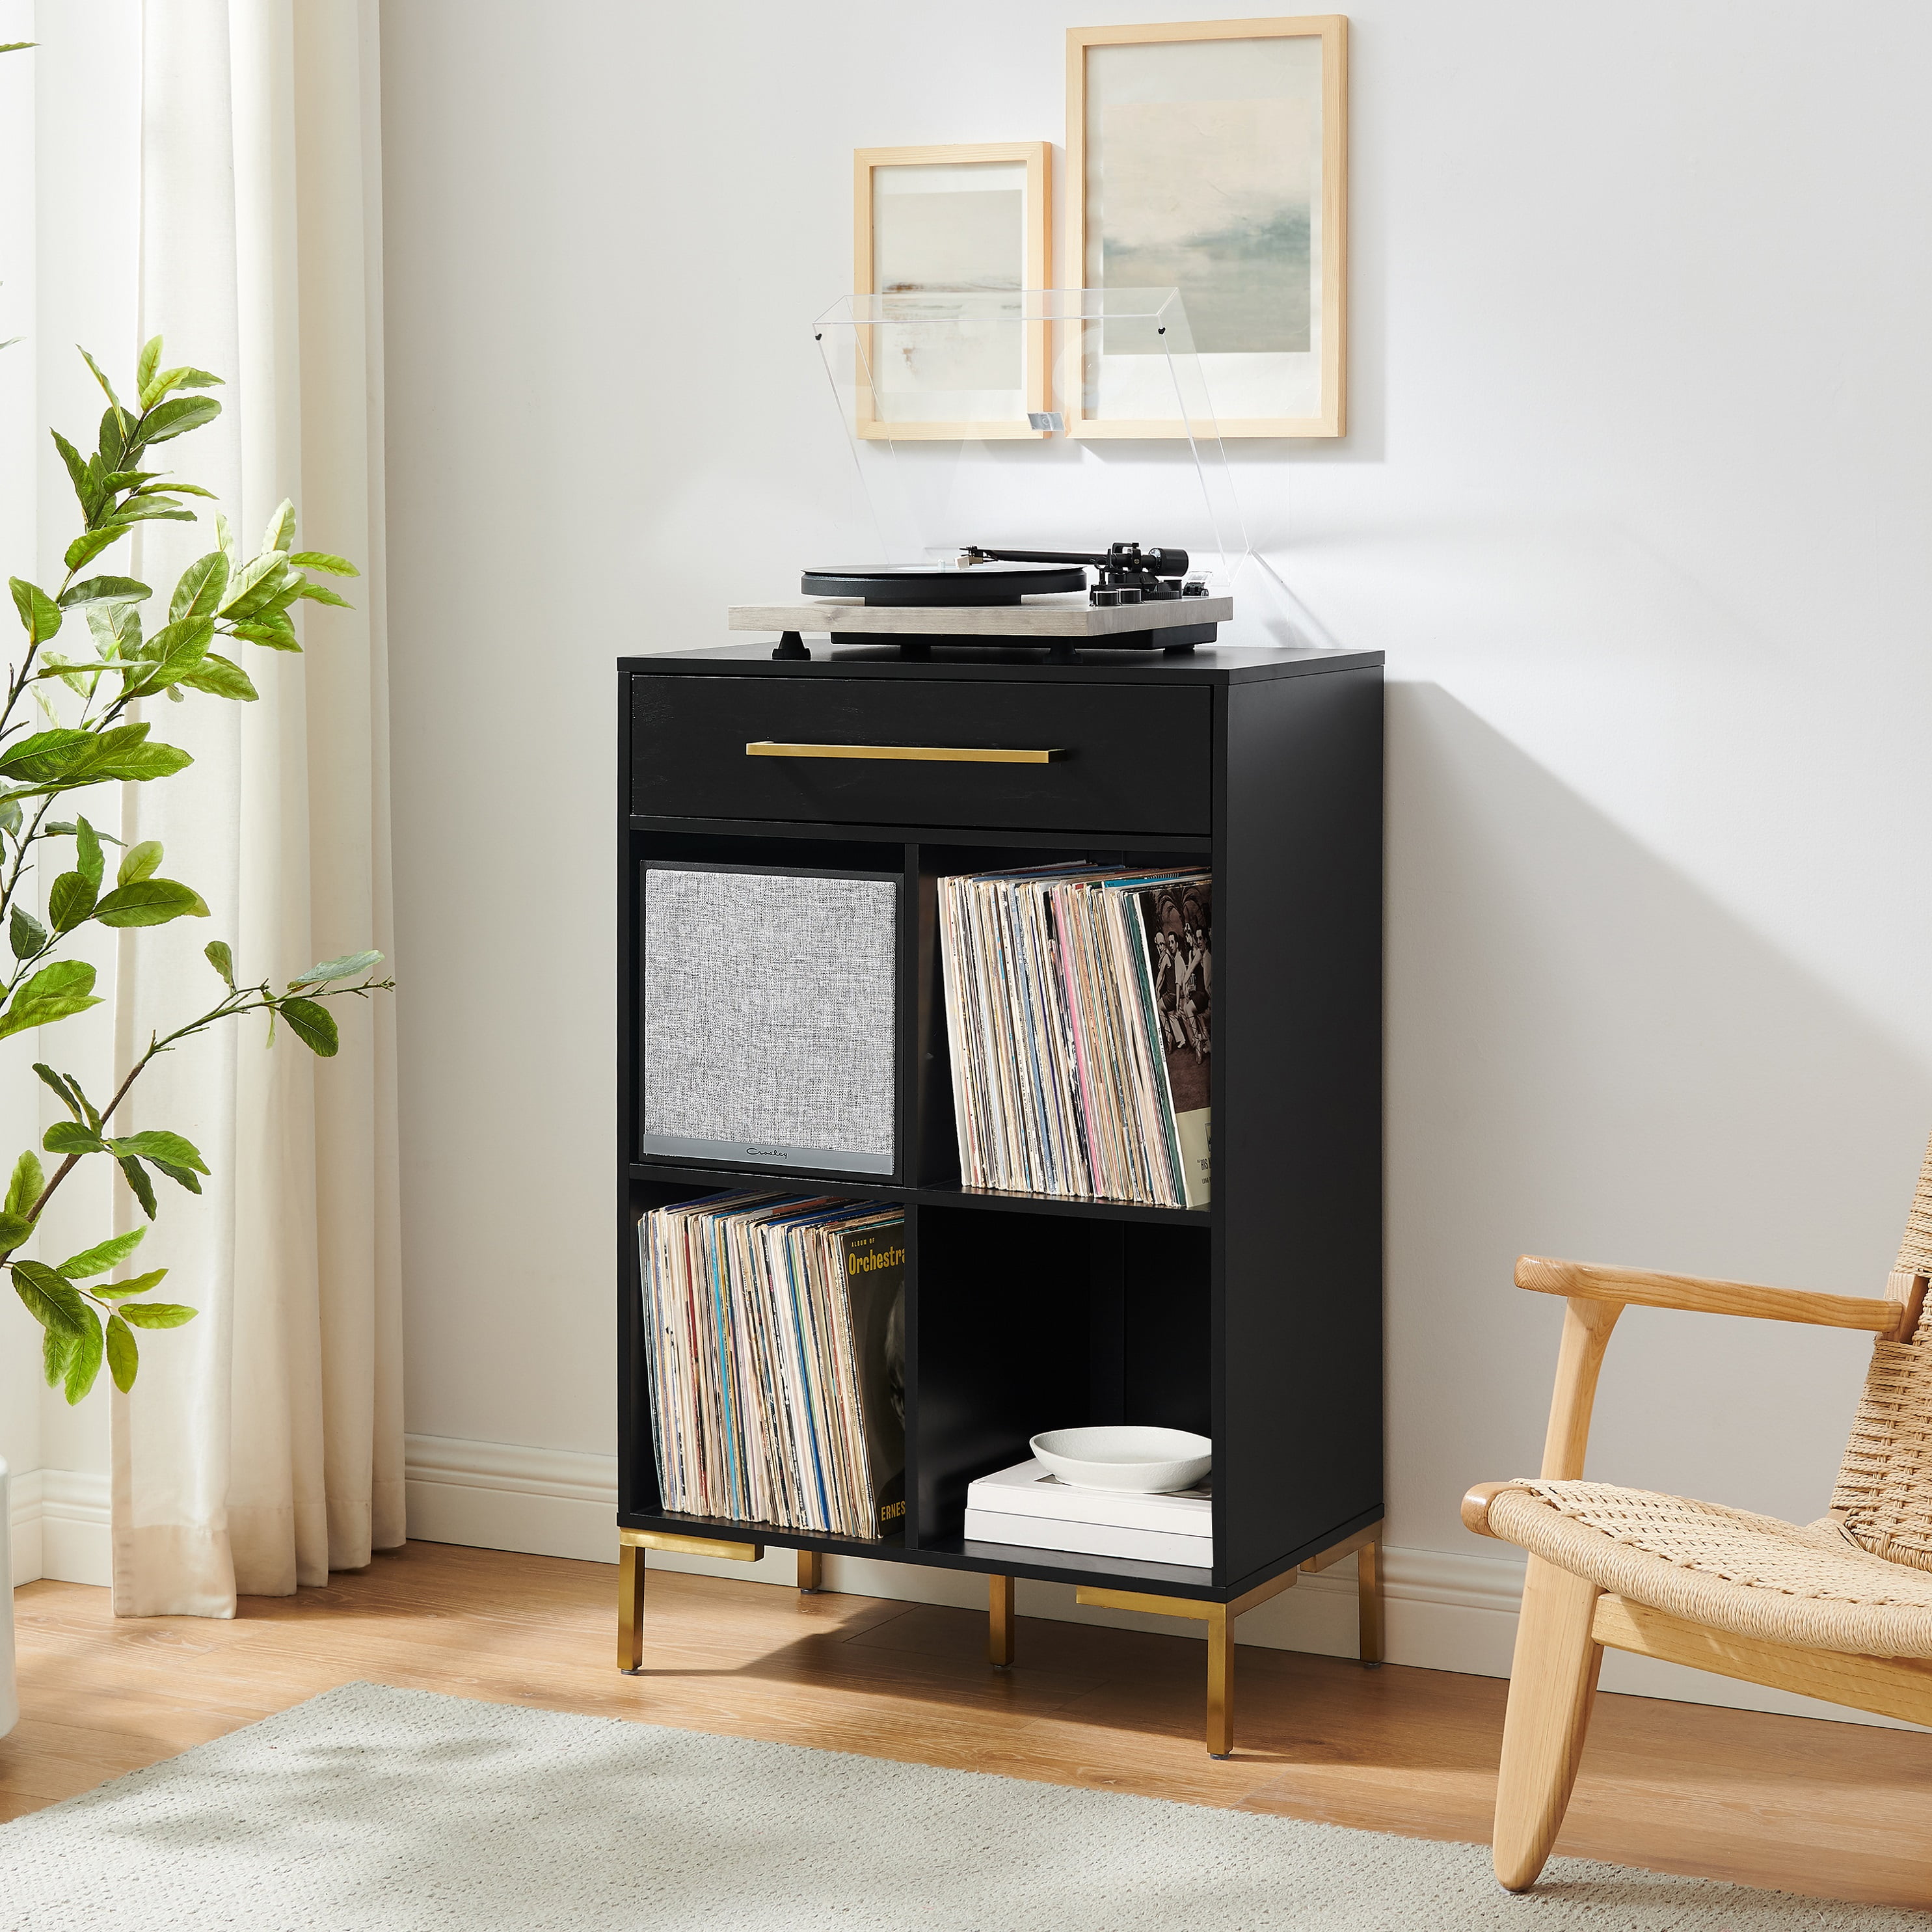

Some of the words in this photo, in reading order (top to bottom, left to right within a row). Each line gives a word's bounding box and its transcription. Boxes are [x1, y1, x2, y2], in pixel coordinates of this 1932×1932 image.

[746, 1147, 787, 1159] Crosley
[851, 1239, 867, 1248] ALBUM
[881, 1500, 906, 1522] ERNES
